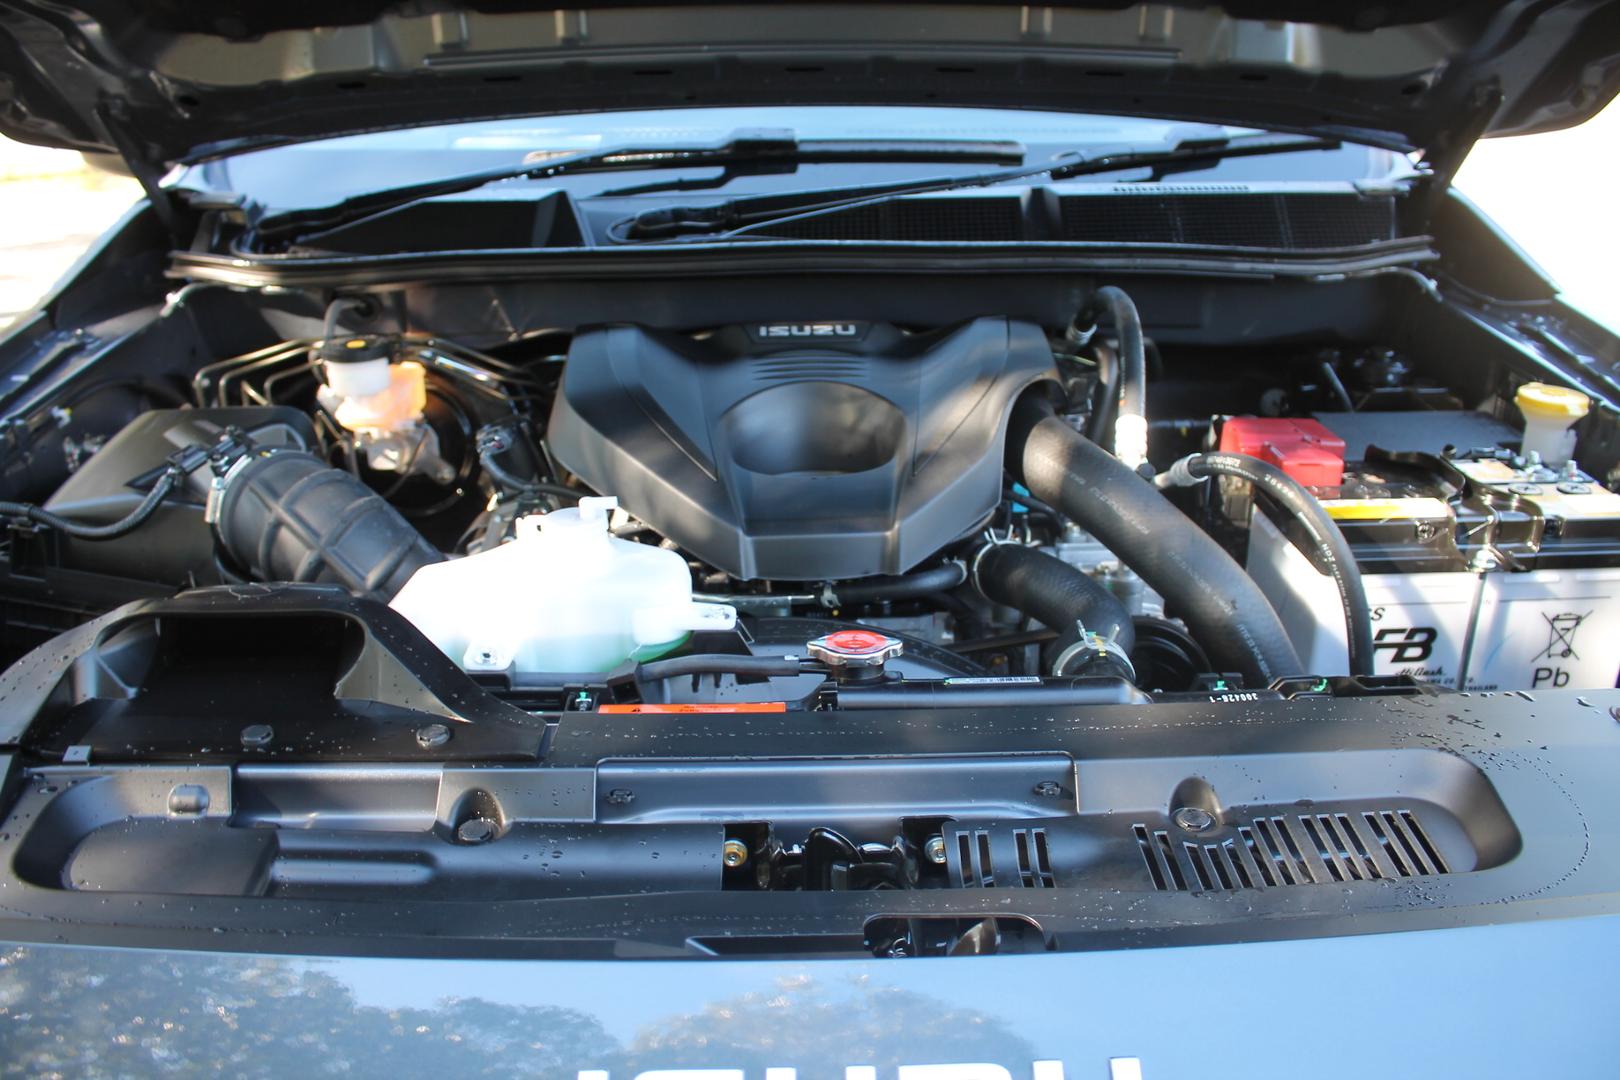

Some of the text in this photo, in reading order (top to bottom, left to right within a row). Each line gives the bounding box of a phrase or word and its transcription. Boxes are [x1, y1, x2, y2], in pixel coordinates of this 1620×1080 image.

[759, 324, 857, 337] ISUZU
[1372, 627, 1438, 663] FB
[1531, 667, 1571, 689] Pb
